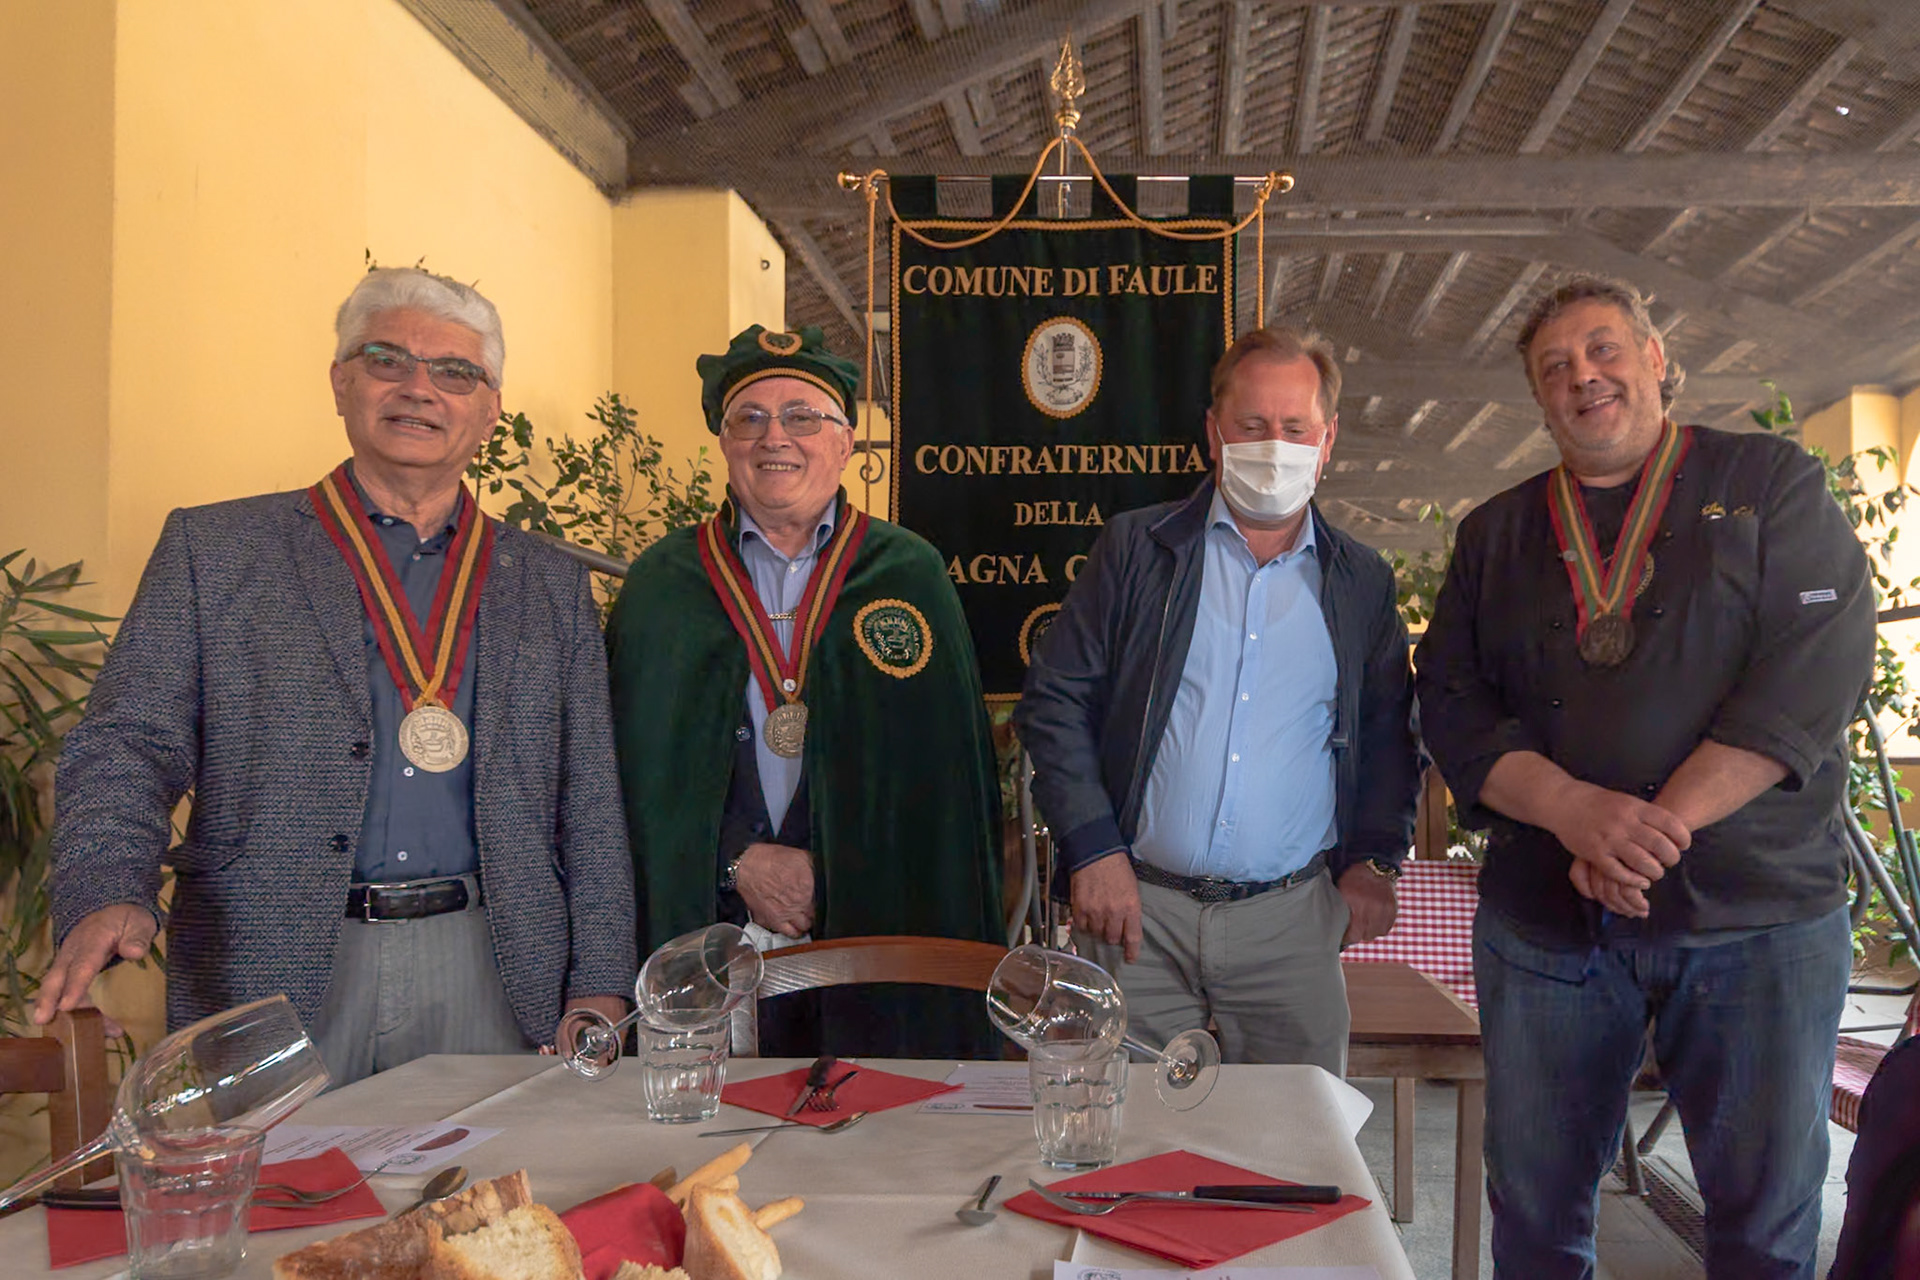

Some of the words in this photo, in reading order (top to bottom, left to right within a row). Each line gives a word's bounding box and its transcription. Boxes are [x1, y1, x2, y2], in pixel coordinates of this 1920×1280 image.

[902, 264, 1054, 297] COMUNE
[1062, 266, 1101, 297] DI
[1107, 264, 1218, 296] FAULE
[915, 443, 1208, 476] CONFRATERNITA
[1013, 500, 1105, 526] DELLA
[946, 553, 1049, 585] AGNA
